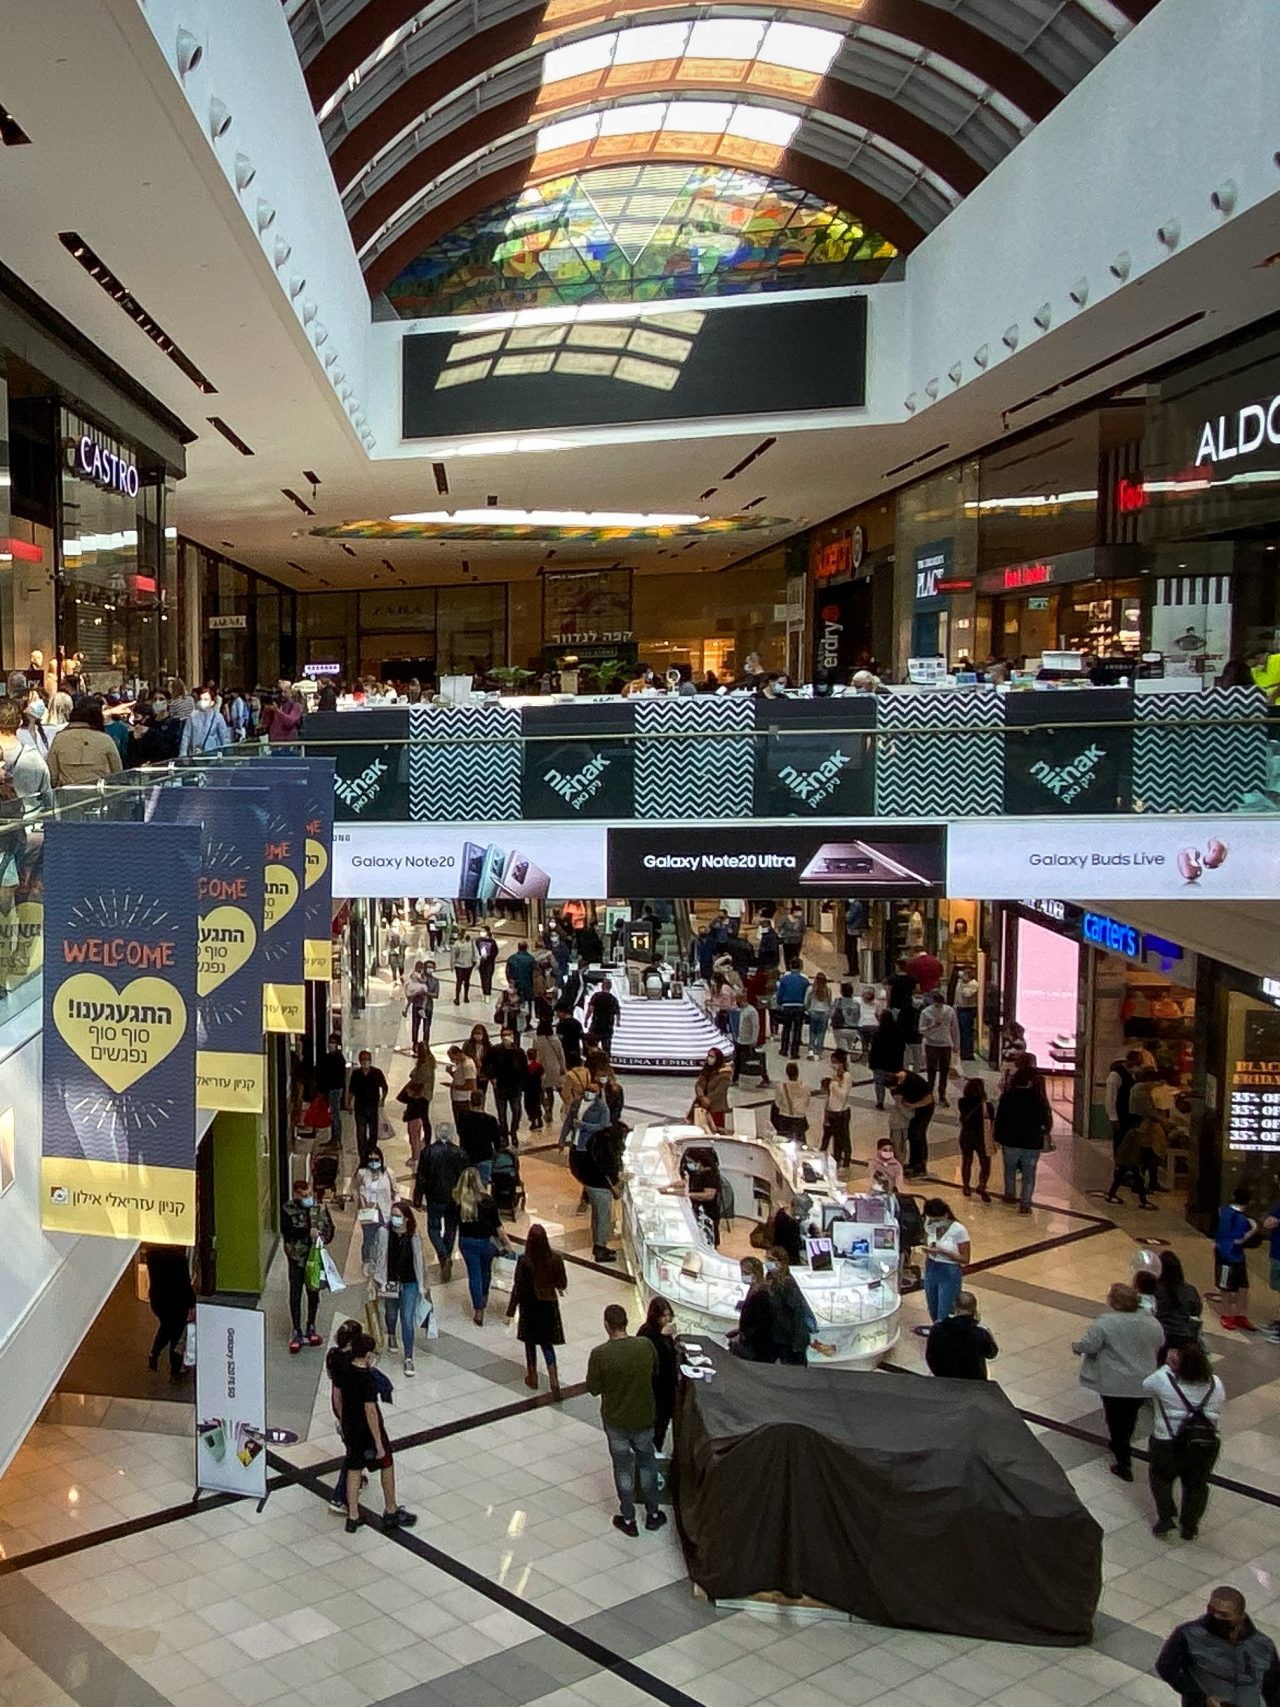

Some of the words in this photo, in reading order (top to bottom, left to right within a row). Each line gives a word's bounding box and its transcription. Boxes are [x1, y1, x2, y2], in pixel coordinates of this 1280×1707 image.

[80, 436, 139, 498] CASTRO
[602, 631, 634, 643] קפה
[824, 620, 844, 668] erdry
[351, 856, 404, 870] Galaxy
[405, 855, 455, 868] Note20
[643, 854, 700, 871] Galaxy
[702, 854, 756, 868] Note20
[758, 854, 797, 868] Ultra
[1029, 853, 1089, 869] Galaxy
[1091, 853, 1131, 866] Buds
[1133, 851, 1166, 866] Live
[197, 875, 249, 900] COME
[1084, 912, 1137, 957] carter's
[63, 938, 176, 970] WELCOME
[204, 945, 228, 961] סוף
[68, 998, 172, 1025] התגעגענו!
[281, 1004, 299, 1016] קניון
[88, 1025, 117, 1046] סוף
[121, 1027, 151, 1048] סוף
[90, 1046, 148, 1064] נפגשים
[196, 1075, 232, 1088] עזריאל
[233, 1078, 256, 1091] קניון
[1261, 1092, 1280, 1104] OF
[1261, 1105, 1280, 1116] OF
[1260, 1118, 1280, 1130] OF
[1259, 1131, 1280, 1143] OF
[72, 1189, 102, 1207] אילון
[105, 1191, 155, 1212] עזריאלי
[158, 1199, 186, 1217] קניון
[225, 1327, 236, 1360] Galaxy
